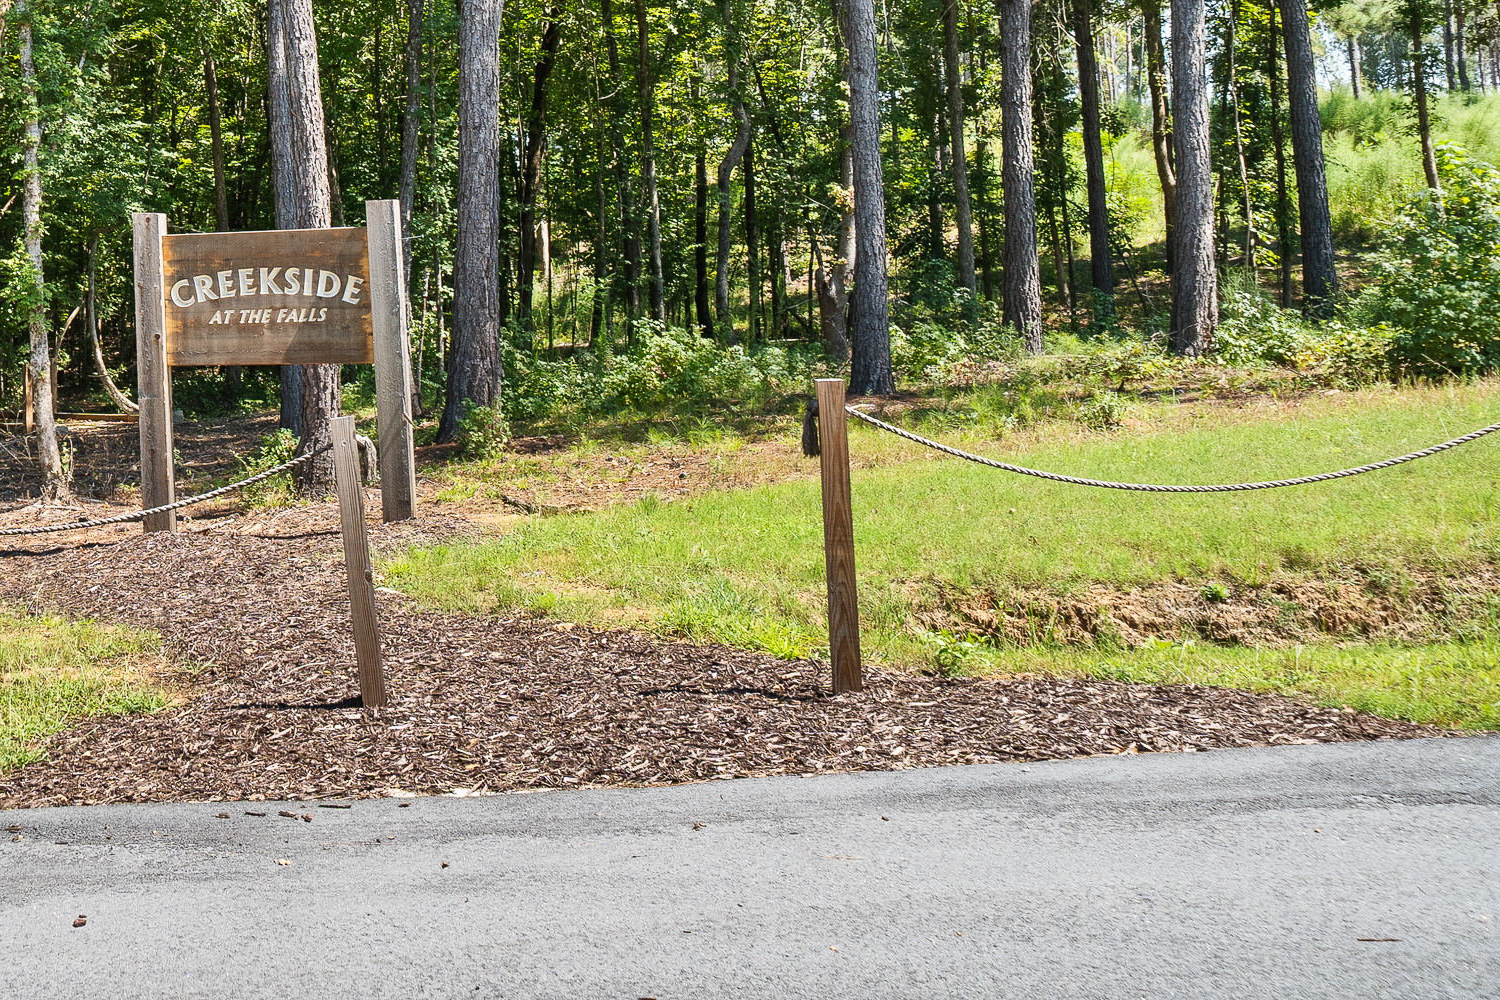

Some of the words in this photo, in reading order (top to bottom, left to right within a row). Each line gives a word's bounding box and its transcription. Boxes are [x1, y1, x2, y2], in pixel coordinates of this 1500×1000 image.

[170, 267, 365, 308] CREEKSIDE
[209, 309, 235, 325] AT
[239, 308, 272, 324] THE
[276, 307, 328, 323] FALLS
